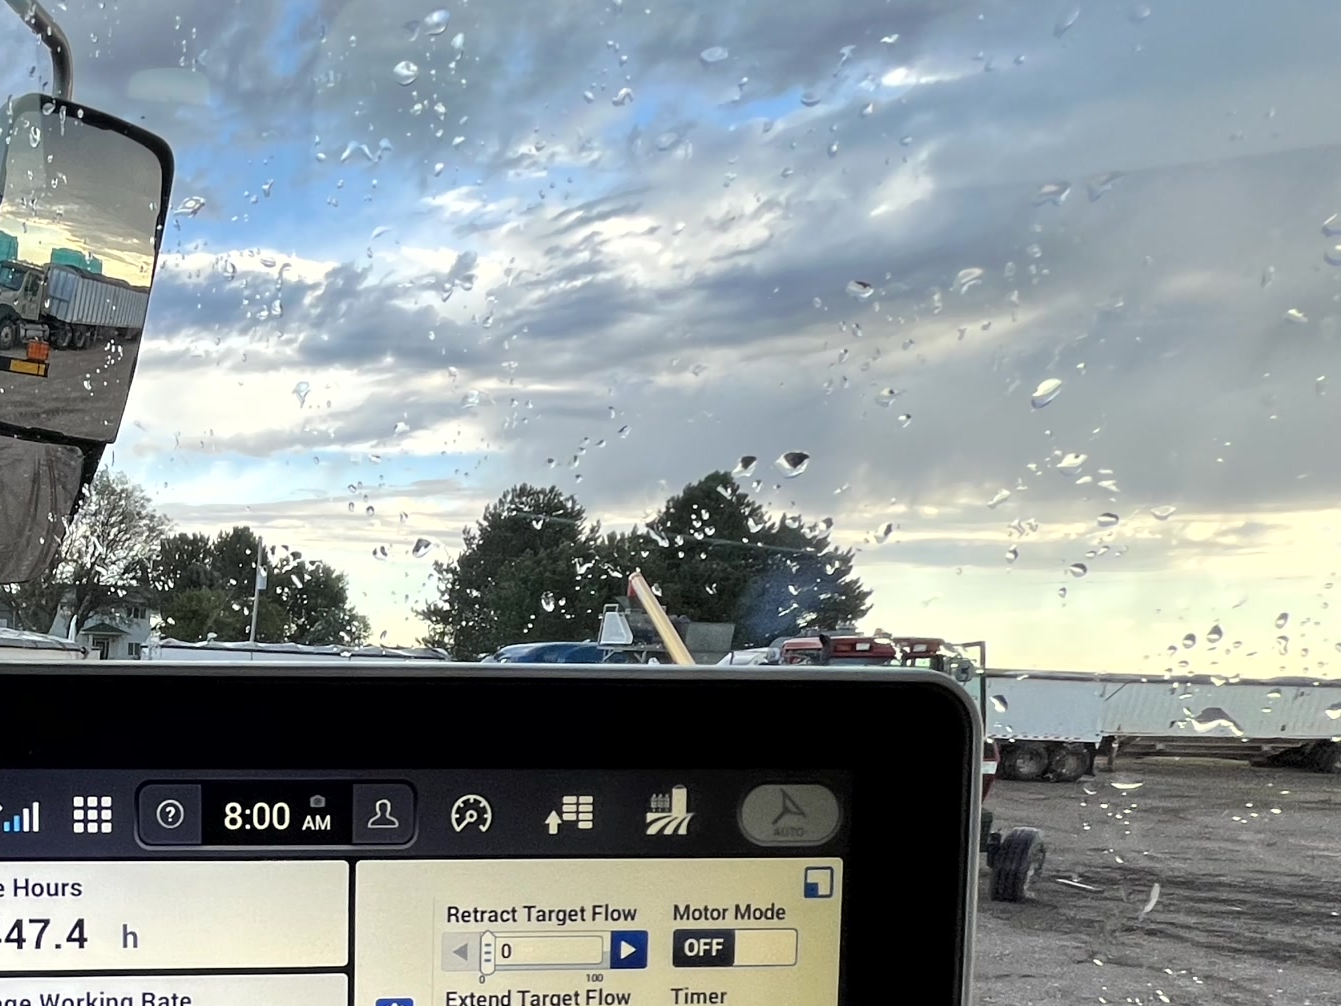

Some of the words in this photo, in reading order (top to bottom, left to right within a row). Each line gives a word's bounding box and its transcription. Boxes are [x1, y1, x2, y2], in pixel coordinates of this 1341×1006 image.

[223, 802, 291, 830] 8:00
[302, 815, 331, 831] AM
[13, 878, 83, 898] Hours
[447, 906, 517, 923] Retract
[523, 905, 586, 926] Target
[592, 905, 637, 921] Flow
[673, 904, 728, 921] Motor
[733, 904, 787, 921] Mode
[122, 924, 138, 948] h
[500, 943, 512, 960] 0
[683, 939, 724, 957] OFF
[478, 975, 486, 984] 0
[586, 973, 604, 982] 100
[586, 990, 631, 1006] Flow
[671, 988, 727, 1005] Timer
